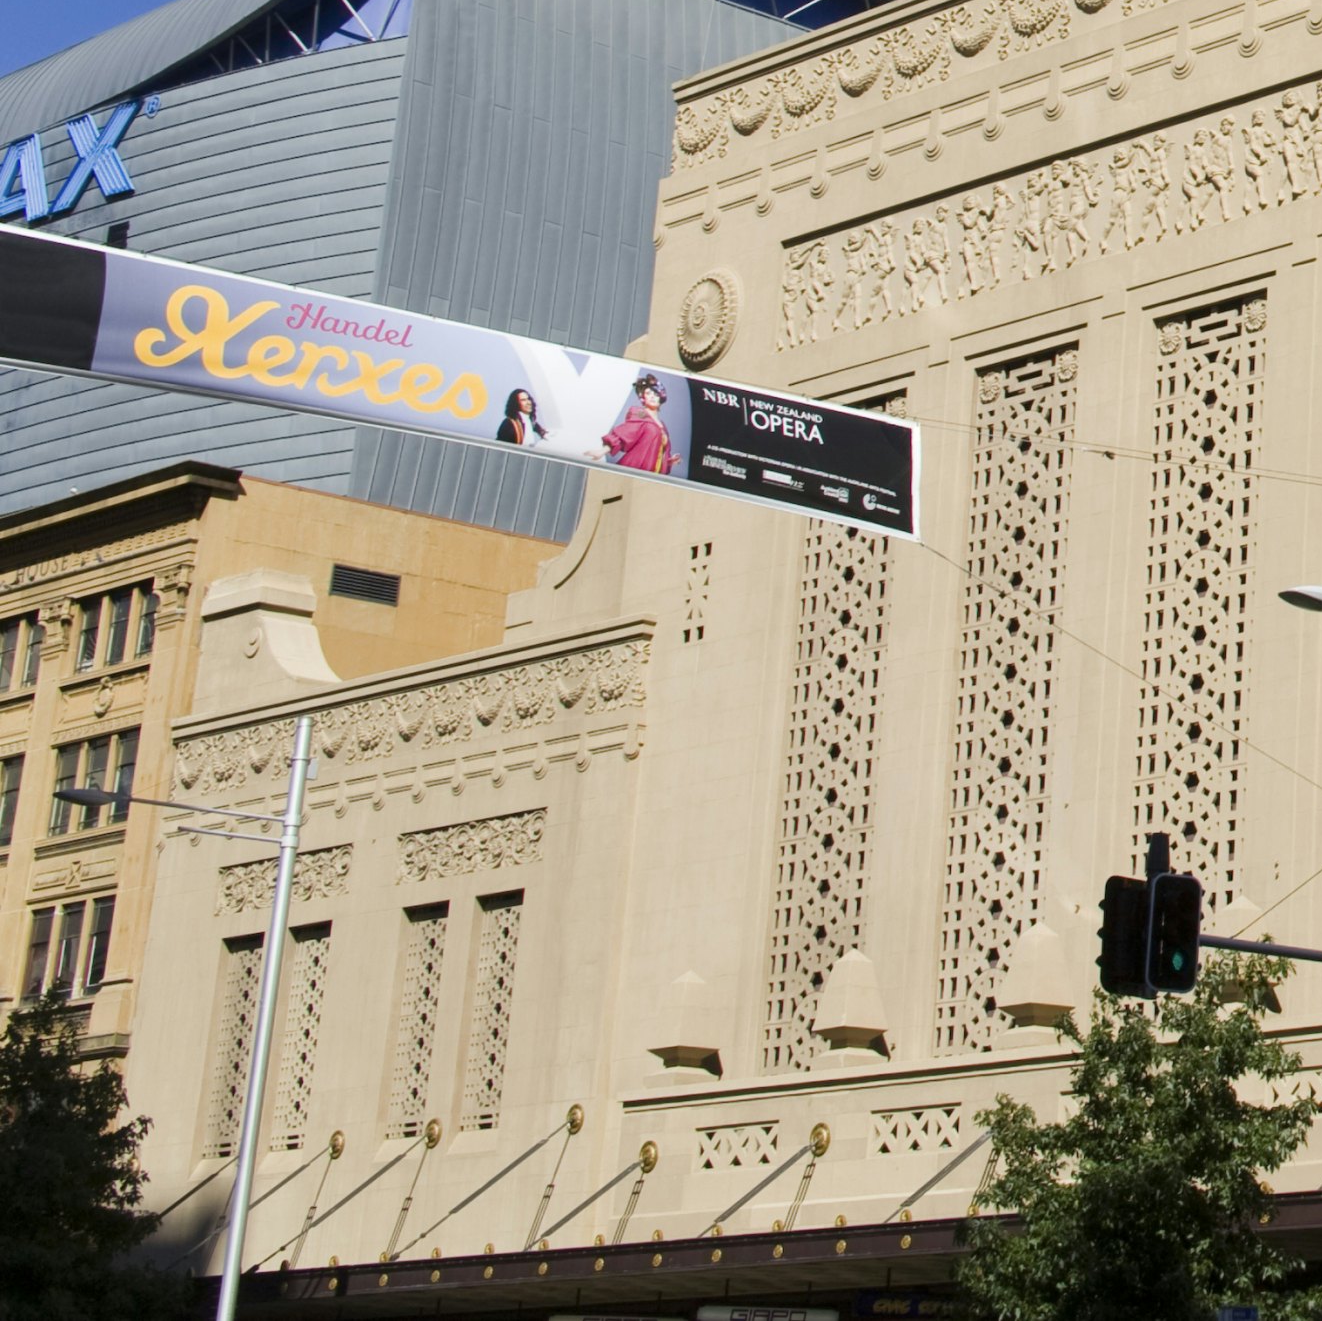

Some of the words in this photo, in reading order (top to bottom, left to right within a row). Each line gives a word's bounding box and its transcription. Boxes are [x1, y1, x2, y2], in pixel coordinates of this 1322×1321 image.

[286, 302, 414, 348] Handel
[134, 284, 489, 420] Xerxes
[702, 387, 740, 408] NBR
[749, 398, 774, 411] NEW
[776, 405, 823, 423] ZEALAND
[750, 410, 824, 445] OPERA
